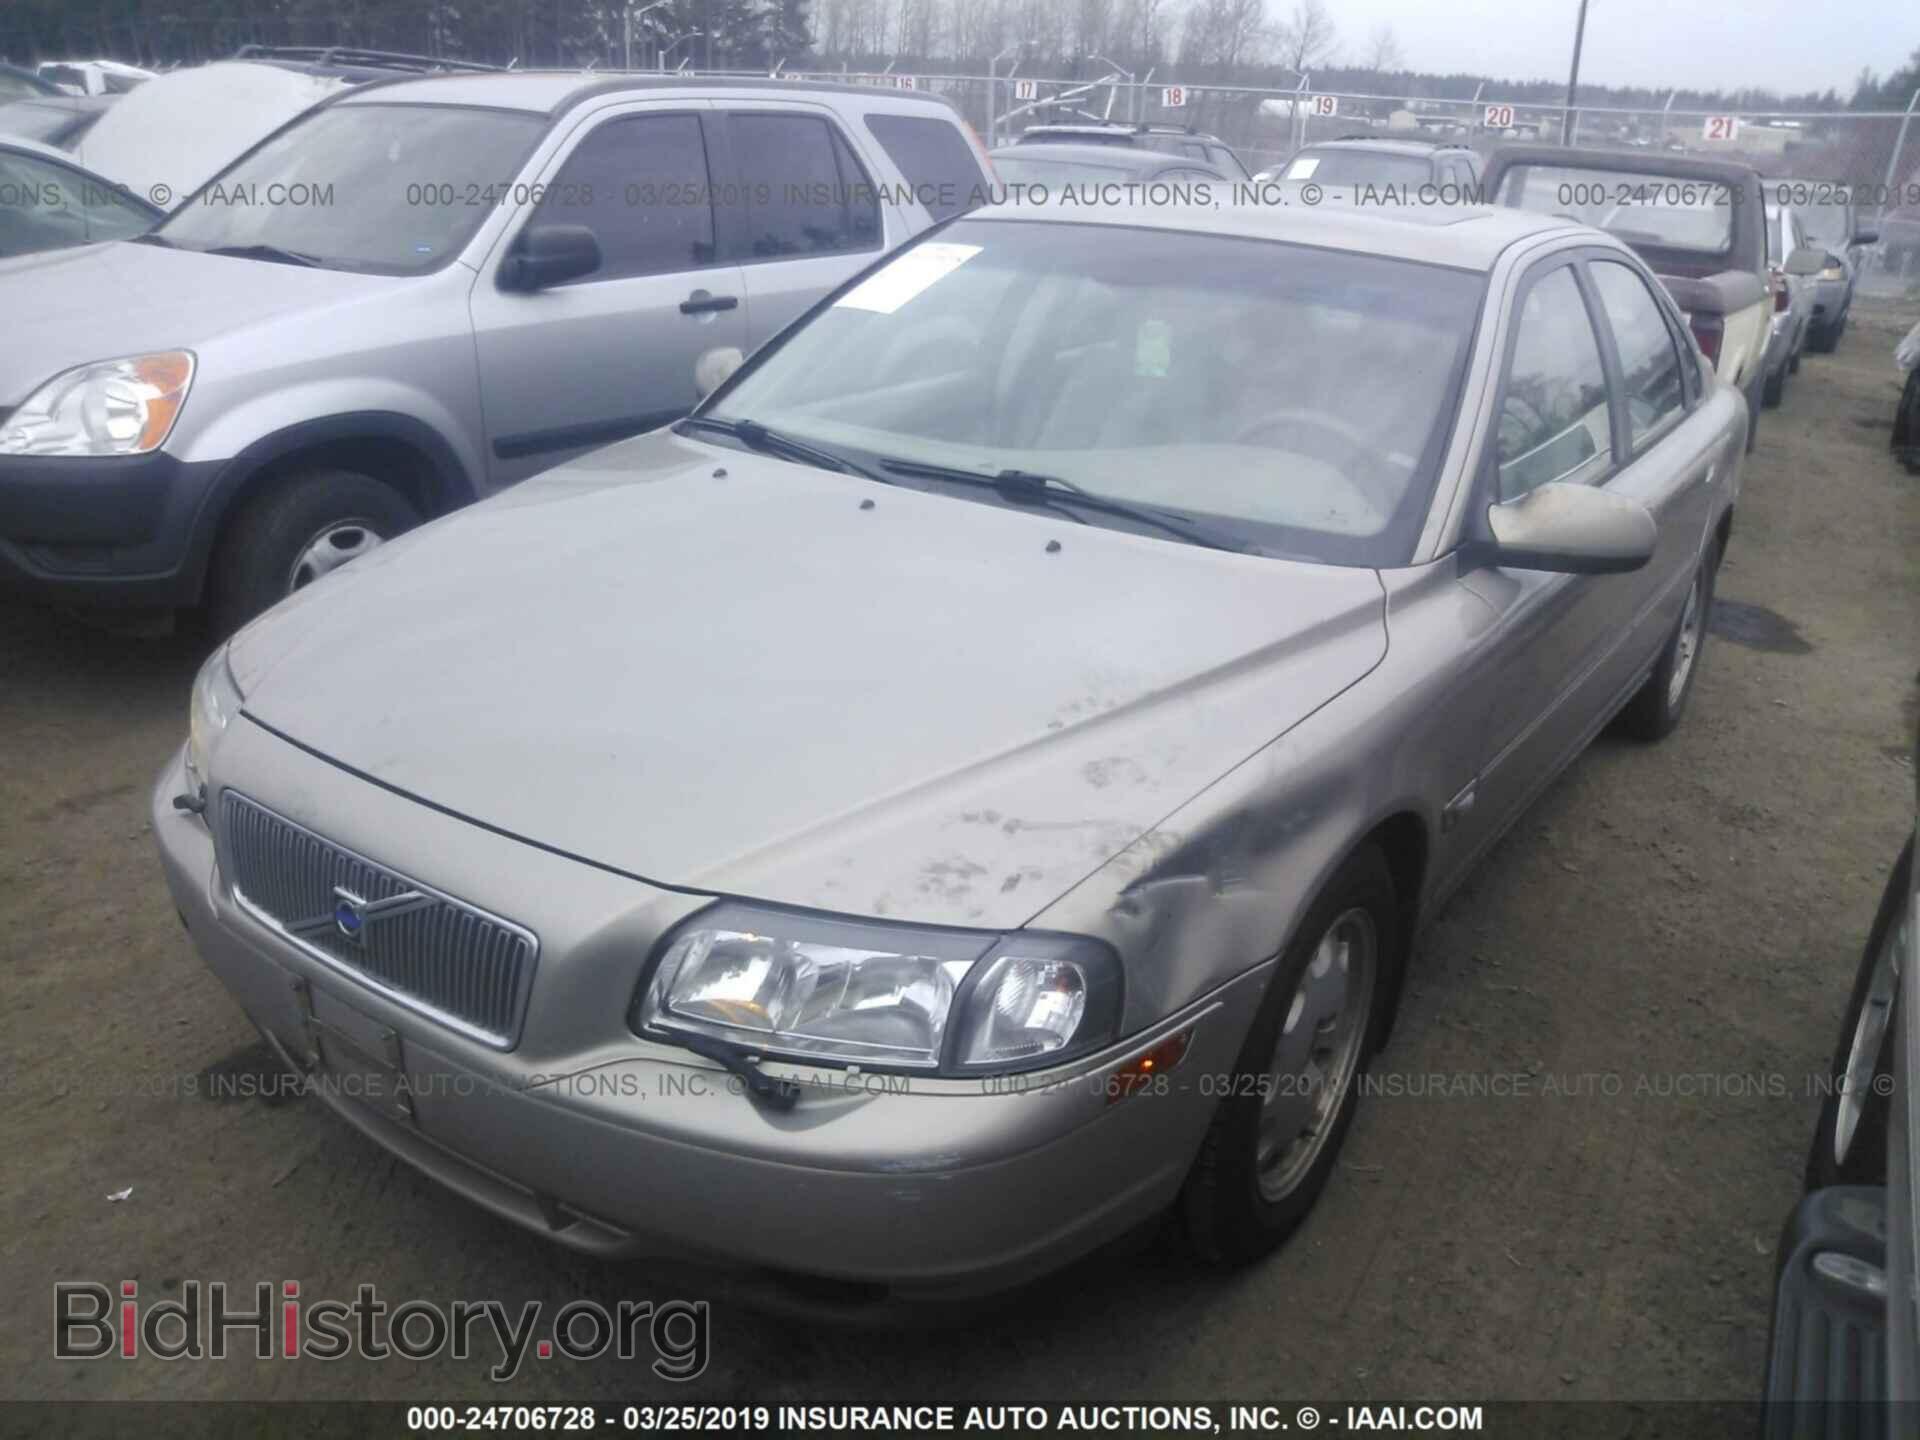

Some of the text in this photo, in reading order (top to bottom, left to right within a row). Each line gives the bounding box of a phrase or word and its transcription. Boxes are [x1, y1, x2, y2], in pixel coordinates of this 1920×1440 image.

[1019, 81, 1032, 97] 17
[1166, 88, 1181, 106] 18
[1316, 97, 1334, 114] 19
[1487, 107, 1511, 127] 20
[1709, 117, 1733, 139] 21
